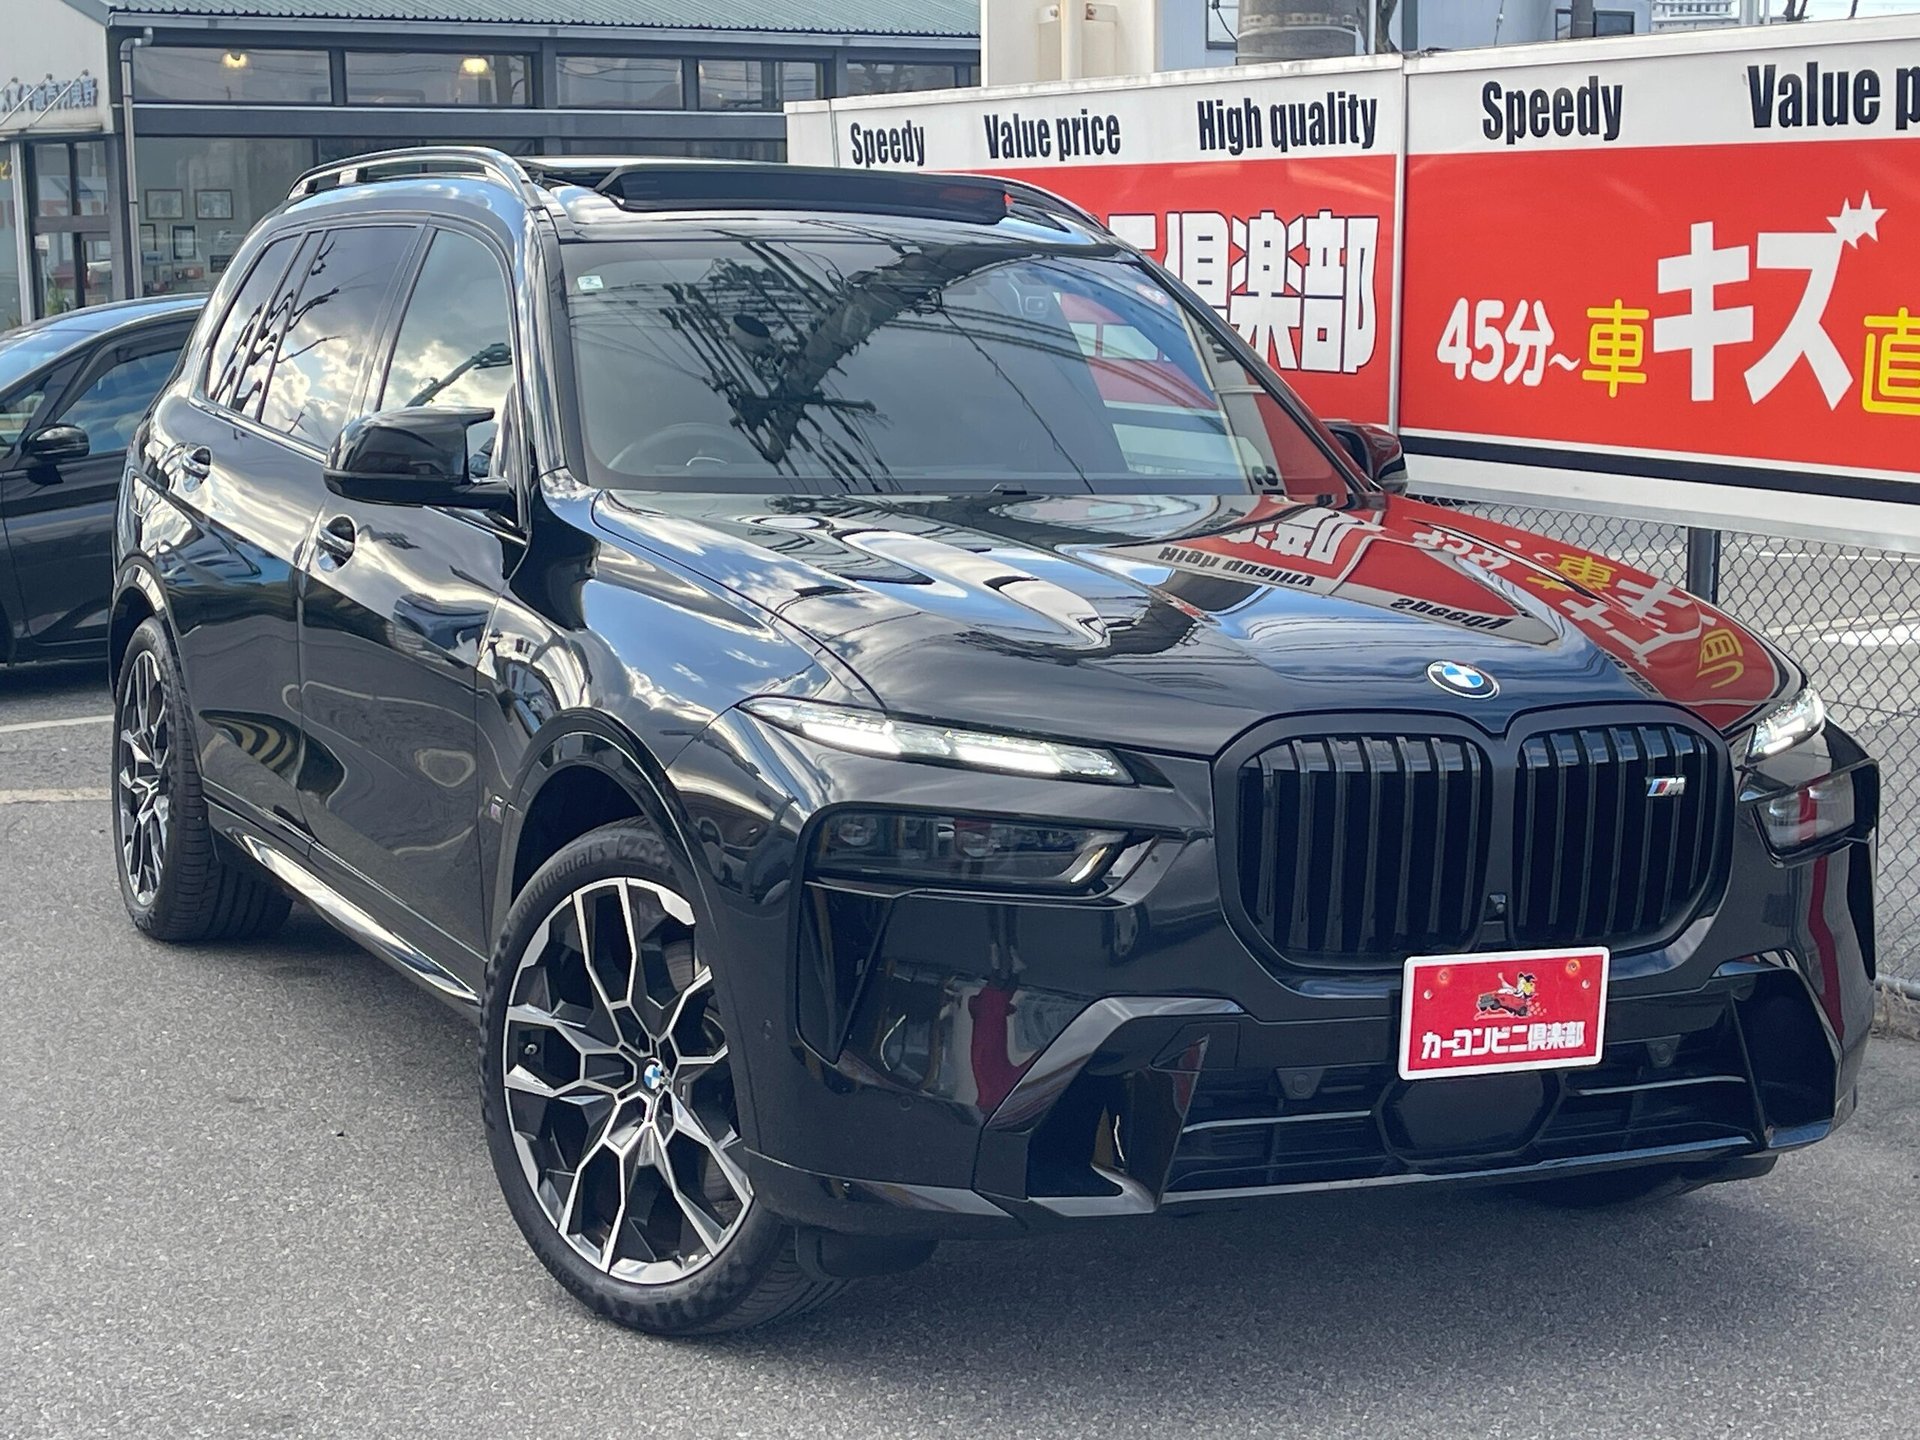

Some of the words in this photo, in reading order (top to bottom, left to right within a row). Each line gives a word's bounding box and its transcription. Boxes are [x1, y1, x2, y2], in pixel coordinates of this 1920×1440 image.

[1197, 97, 1264, 155] High
[1270, 91, 1378, 155] quality
[1482, 76, 1623, 145] Speedy
[1748, 62, 1881, 129] Value
[851, 121, 926, 167] Speedy
[985, 113, 1051, 160] Value
[1058, 109, 1122, 162] price
[1421, 1021, 1586, 1059] カーコンビニ倶楽部
